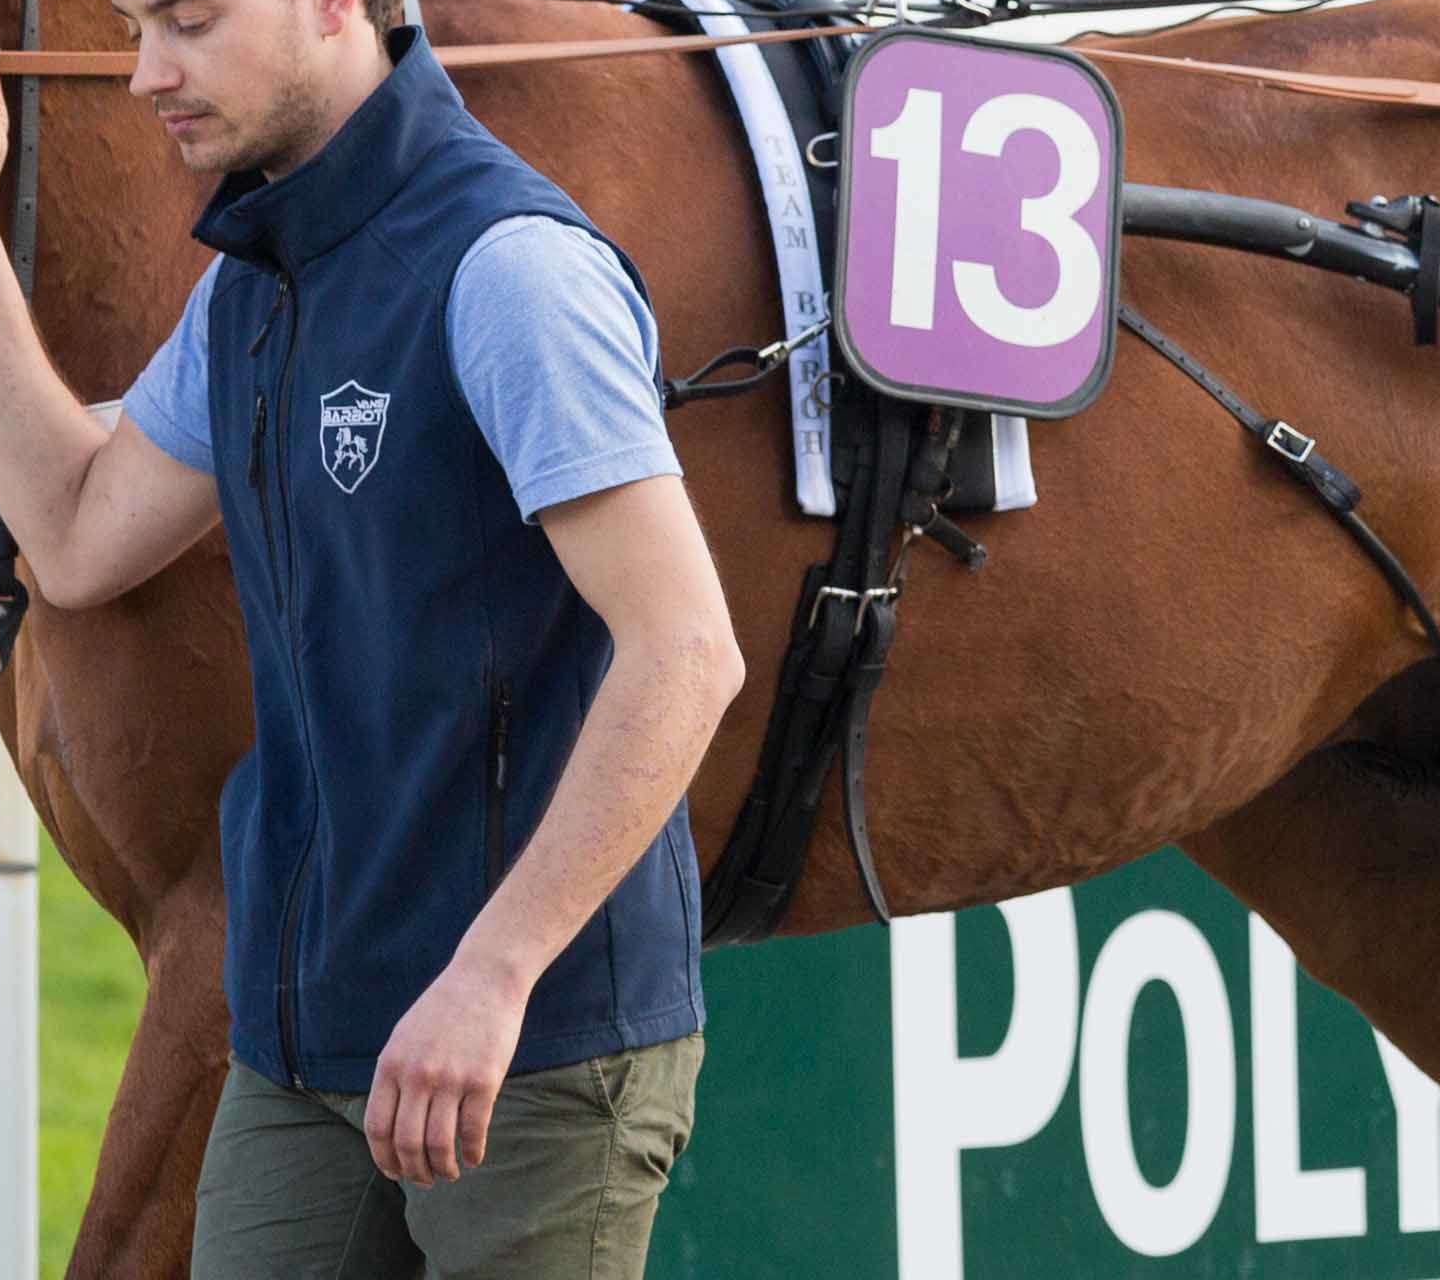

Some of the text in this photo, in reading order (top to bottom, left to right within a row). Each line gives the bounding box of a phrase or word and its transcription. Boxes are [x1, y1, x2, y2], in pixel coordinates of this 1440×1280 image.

[764, 134, 809, 250] TEAM
[870, 88, 1102, 348] 13
[323, 409, 382, 423] BARBOT
[355, 399, 384, 409] VANS
